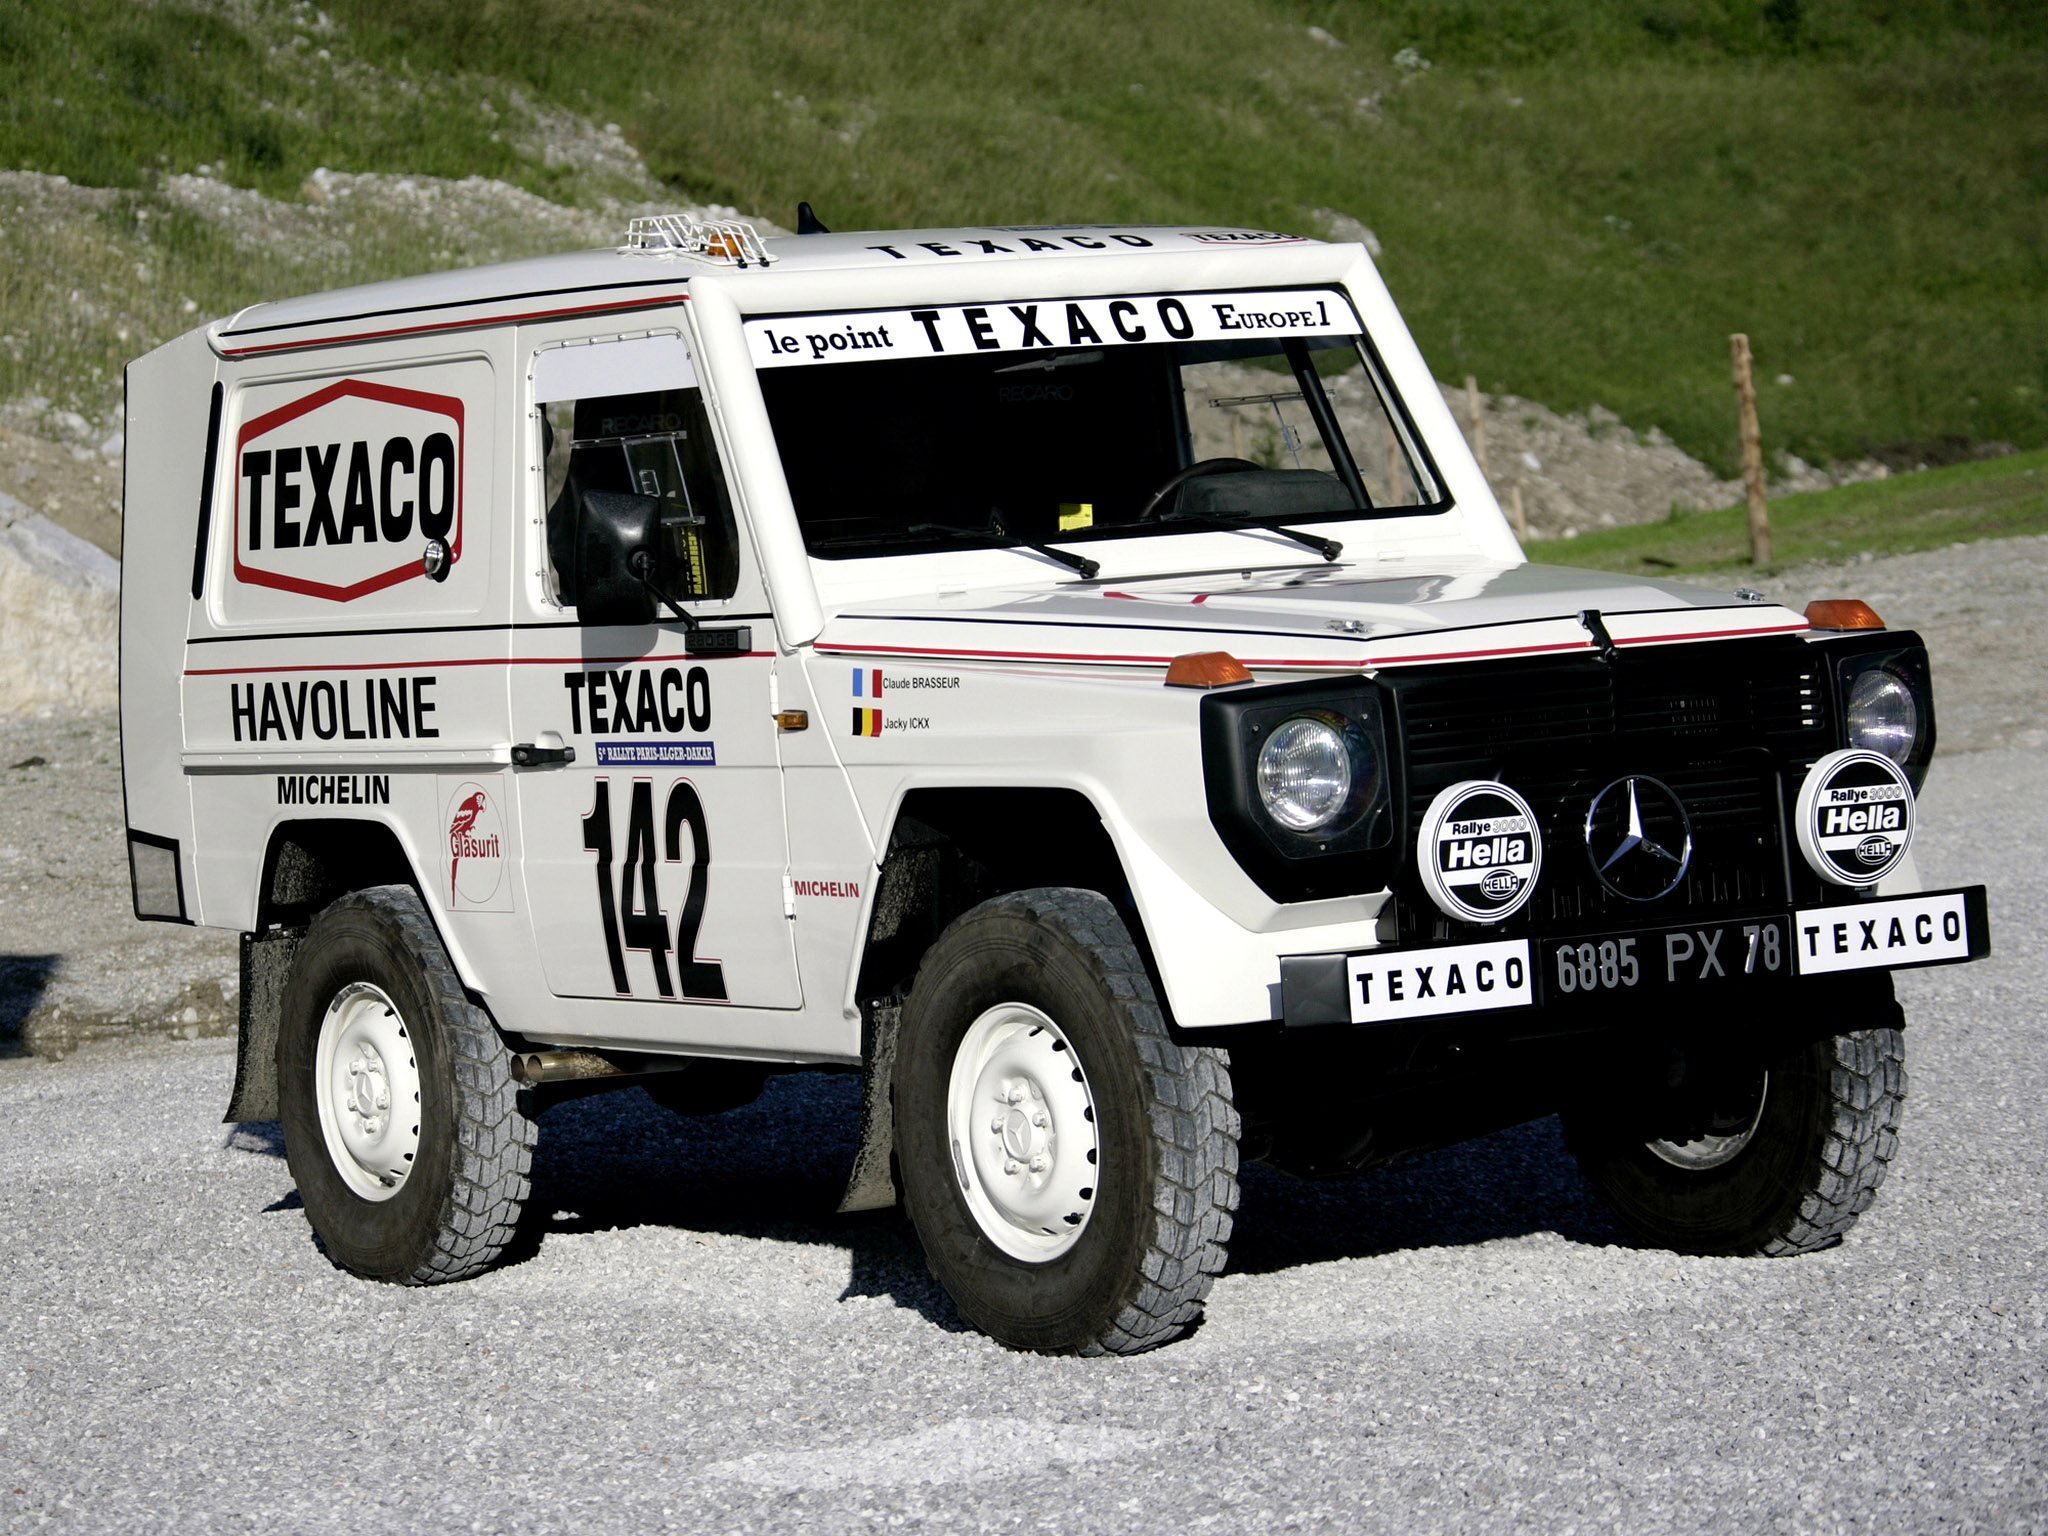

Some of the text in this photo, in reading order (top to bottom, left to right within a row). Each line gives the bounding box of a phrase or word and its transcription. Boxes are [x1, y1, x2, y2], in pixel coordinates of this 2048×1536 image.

[865, 234, 1154, 259] TEXACO
[764, 329, 800, 354] le
[806, 325, 893, 359] point
[910, 297, 1194, 352] TEXACO
[242, 432, 455, 550] TEXACO
[883, 677, 960, 689] Claude BRASSEUR
[230, 676, 439, 742] HAVOLINE
[564, 666, 711, 734] TEXACO
[884, 718, 930, 731] Jacky ICKX
[607, 747, 636, 760] RALLYE
[636, 746, 713, 760] PARIS-ALGER-DAKAR
[277, 775, 390, 805] MICHELIN
[1831, 786, 1903, 803] Rallye 3000
[1452, 818, 1528, 836] Rallye 3000
[1825, 804, 1900, 834] Hella
[450, 832, 500, 858] Glasurit
[1448, 837, 1526, 869] Hella
[1860, 841, 1892, 856] HELLA
[581, 776, 730, 1003] 142
[794, 880, 860, 898] MICHELIN
[1484, 875, 1519, 890] HELLA
[1804, 911, 1961, 957] TEXACO
[1557, 923, 1781, 993] 6885 PX 78
[1356, 957, 1524, 1004] TEXACO
